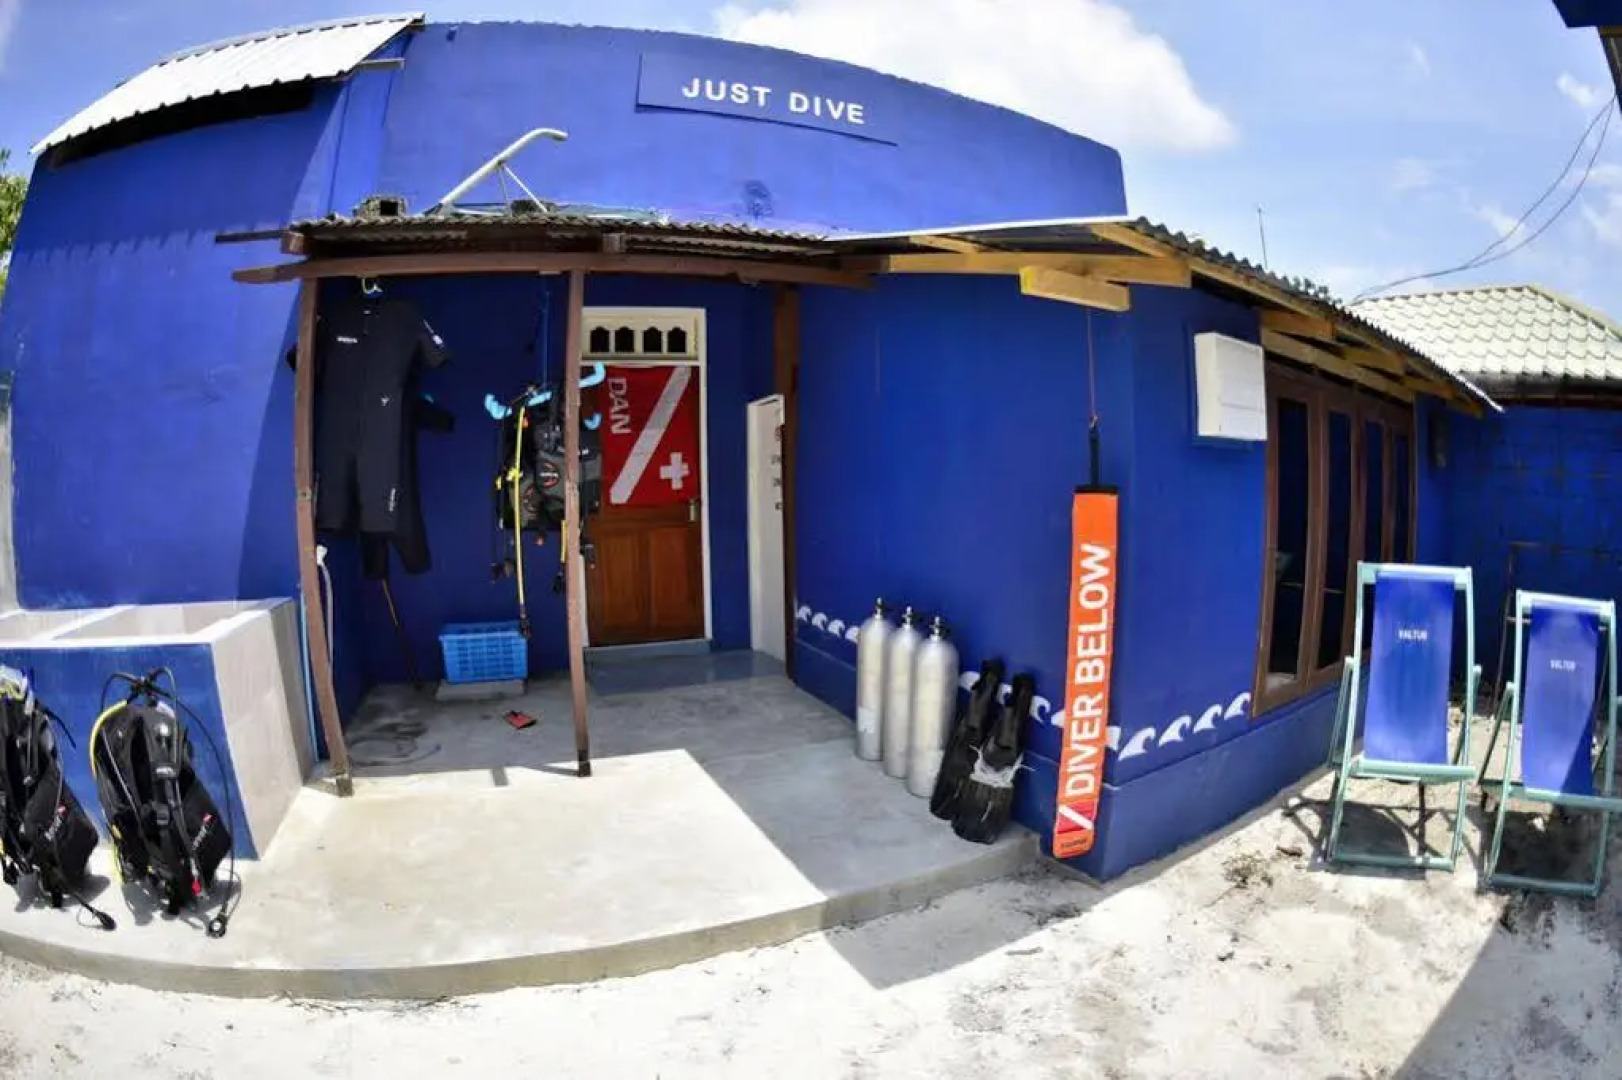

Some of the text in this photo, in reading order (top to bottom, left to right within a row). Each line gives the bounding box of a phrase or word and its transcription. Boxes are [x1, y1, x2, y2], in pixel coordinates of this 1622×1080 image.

[682, 78, 865, 124] JUST DIVE
[609, 377, 631, 434] DAN
[1074, 543, 1112, 685] BELOW
[1066, 691, 1103, 796] DIVER
